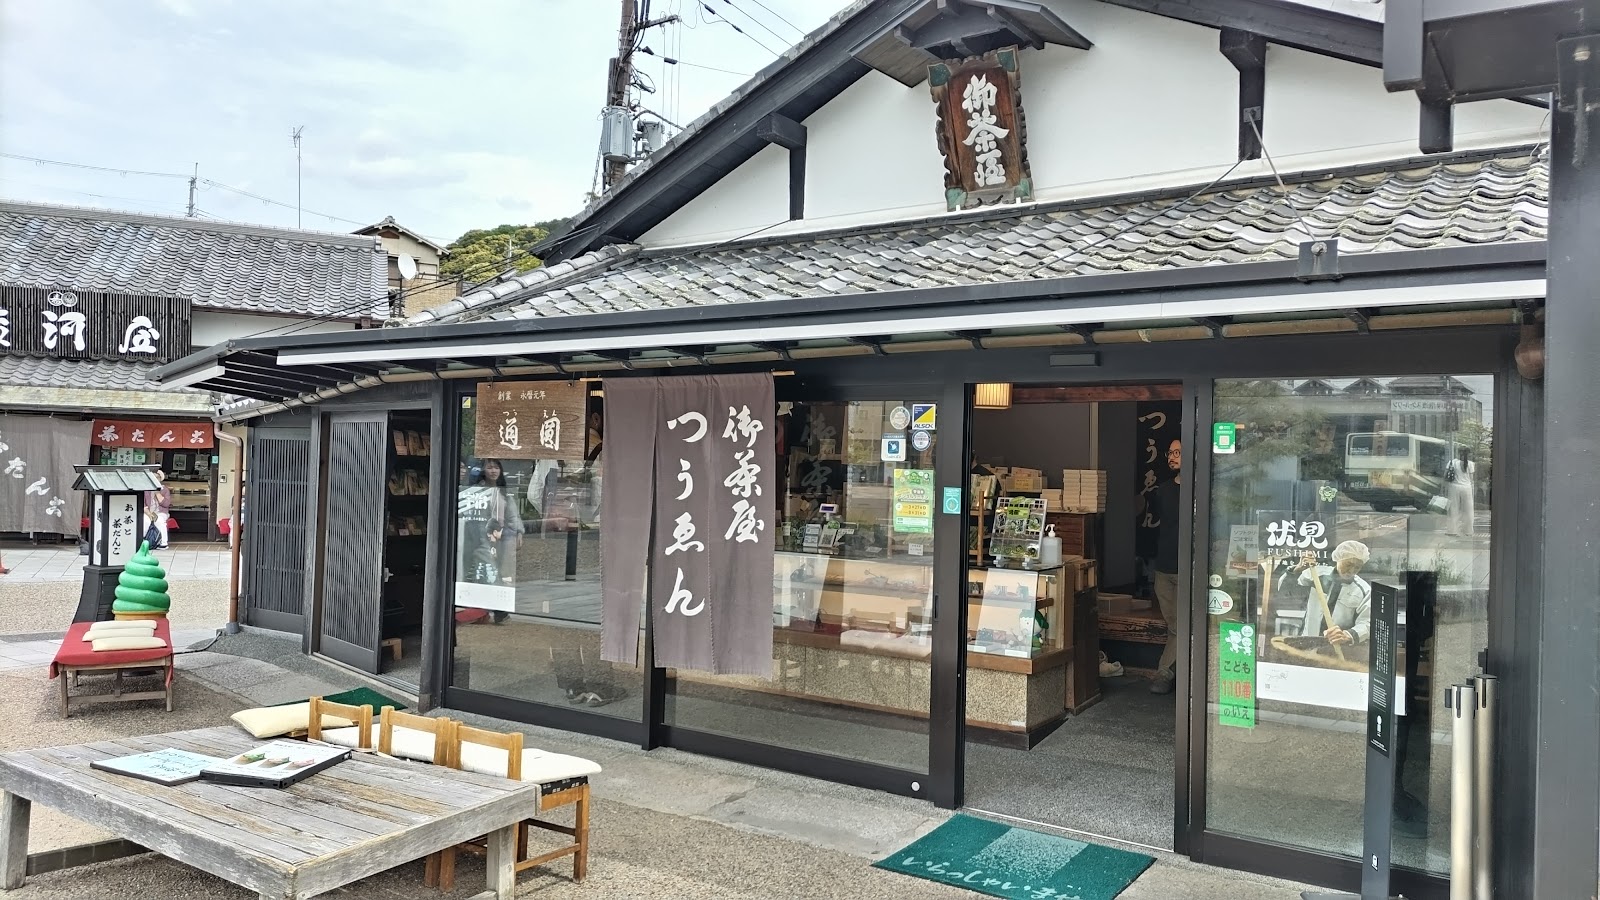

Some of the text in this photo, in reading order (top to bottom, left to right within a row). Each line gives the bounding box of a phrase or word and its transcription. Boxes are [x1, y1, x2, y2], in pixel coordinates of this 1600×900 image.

[0, 307, 160, 354] 河屋
[498, 391, 512, 401] 創業
[722, 404, 765, 544] 御茶屋
[1138, 411, 1167, 528] つうゑん
[123, 503, 134, 536] お茶と
[664, 411, 708, 616] つうゑん
[111, 518, 122, 556] 茶だんご
[1266, 519, 1328, 549] 伏見
[1267, 548, 1328, 559] FUSHIMI
[1224, 660, 1250, 674] こども
[1222, 680, 1252, 699] 110番
[1223, 705, 1250, 720] のいえ
